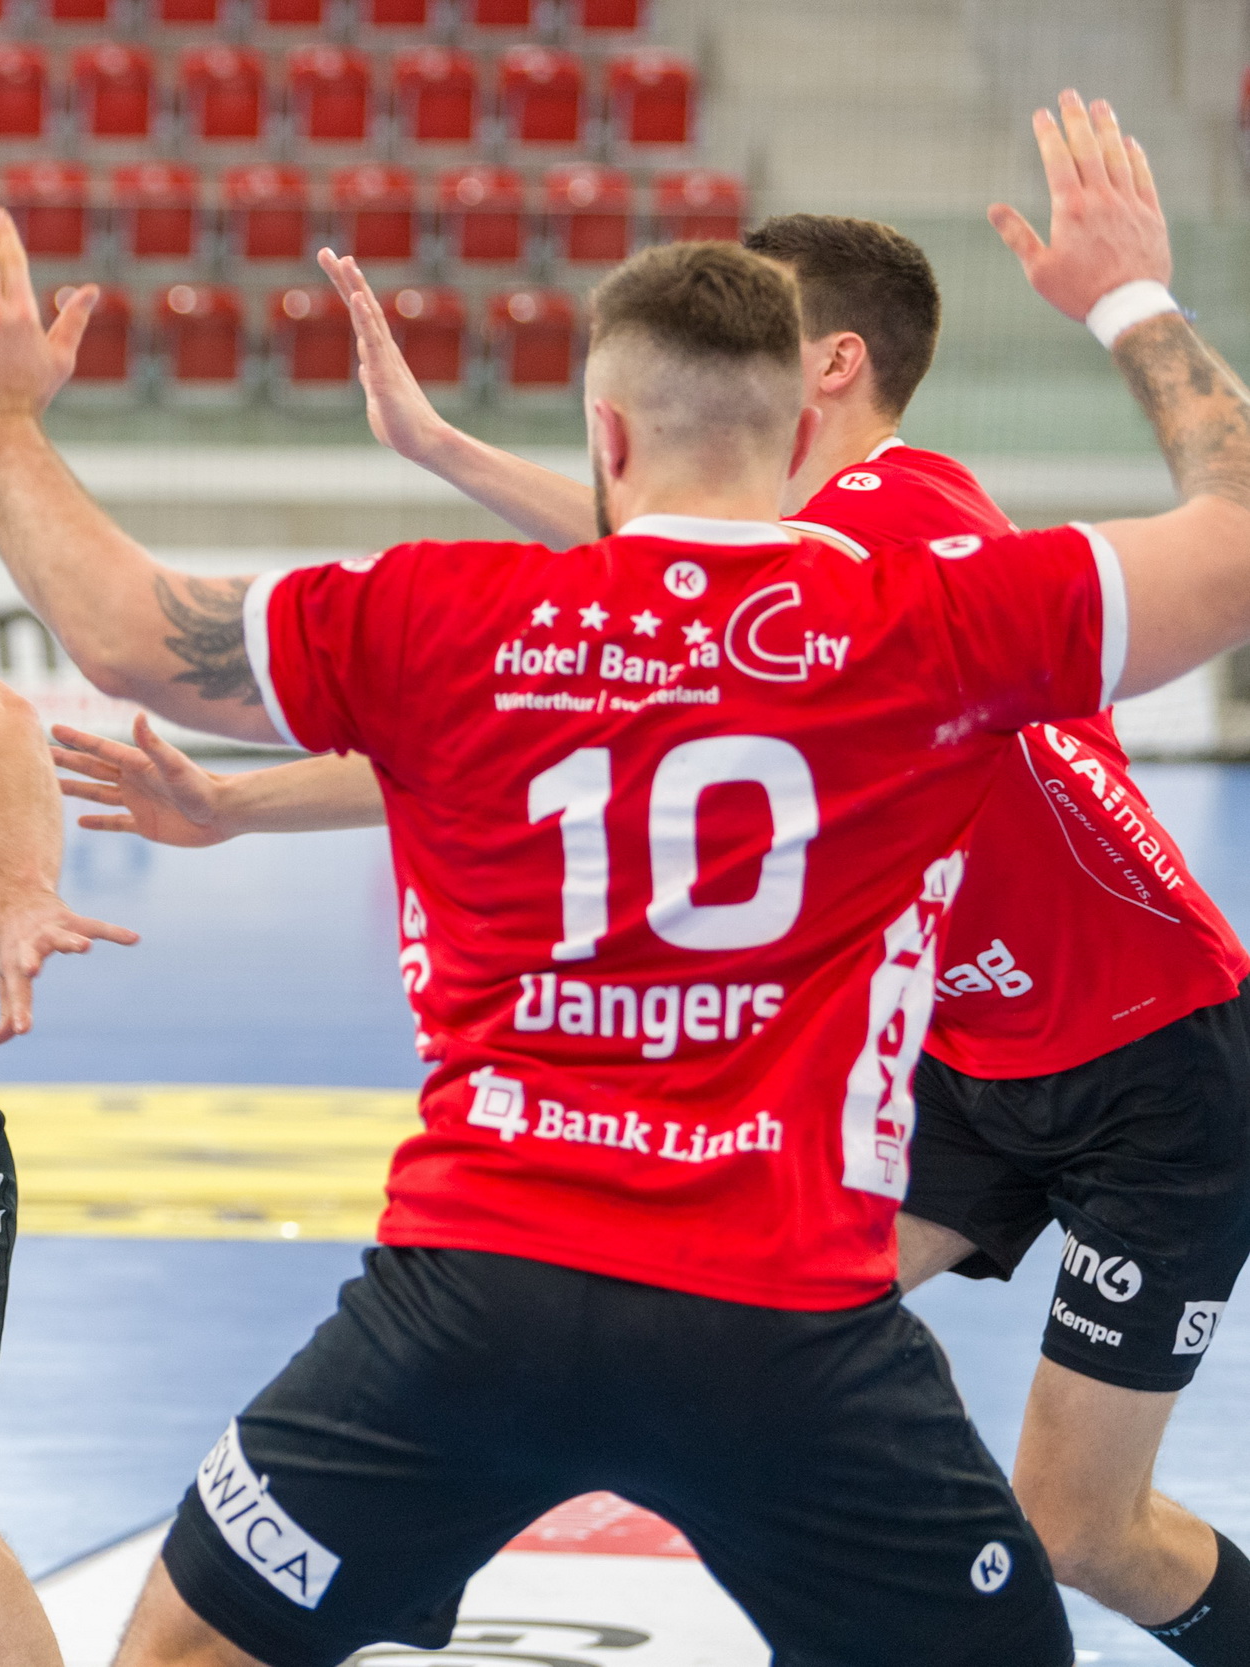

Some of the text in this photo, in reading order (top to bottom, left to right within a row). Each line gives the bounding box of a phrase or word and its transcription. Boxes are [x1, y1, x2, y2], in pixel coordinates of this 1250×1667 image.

[494, 638, 588, 676] Hotel
[724, 582, 850, 682] City
[527, 734, 820, 961] 10
[1045, 778, 1097, 832] Genau
[1123, 868, 1152, 905] uns.
[514, 972, 785, 1059] Dangers
[533, 1099, 652, 1154] Bank
[1051, 1297, 1123, 1347] Kempa
[203, 1434, 308, 1598] SWICA
